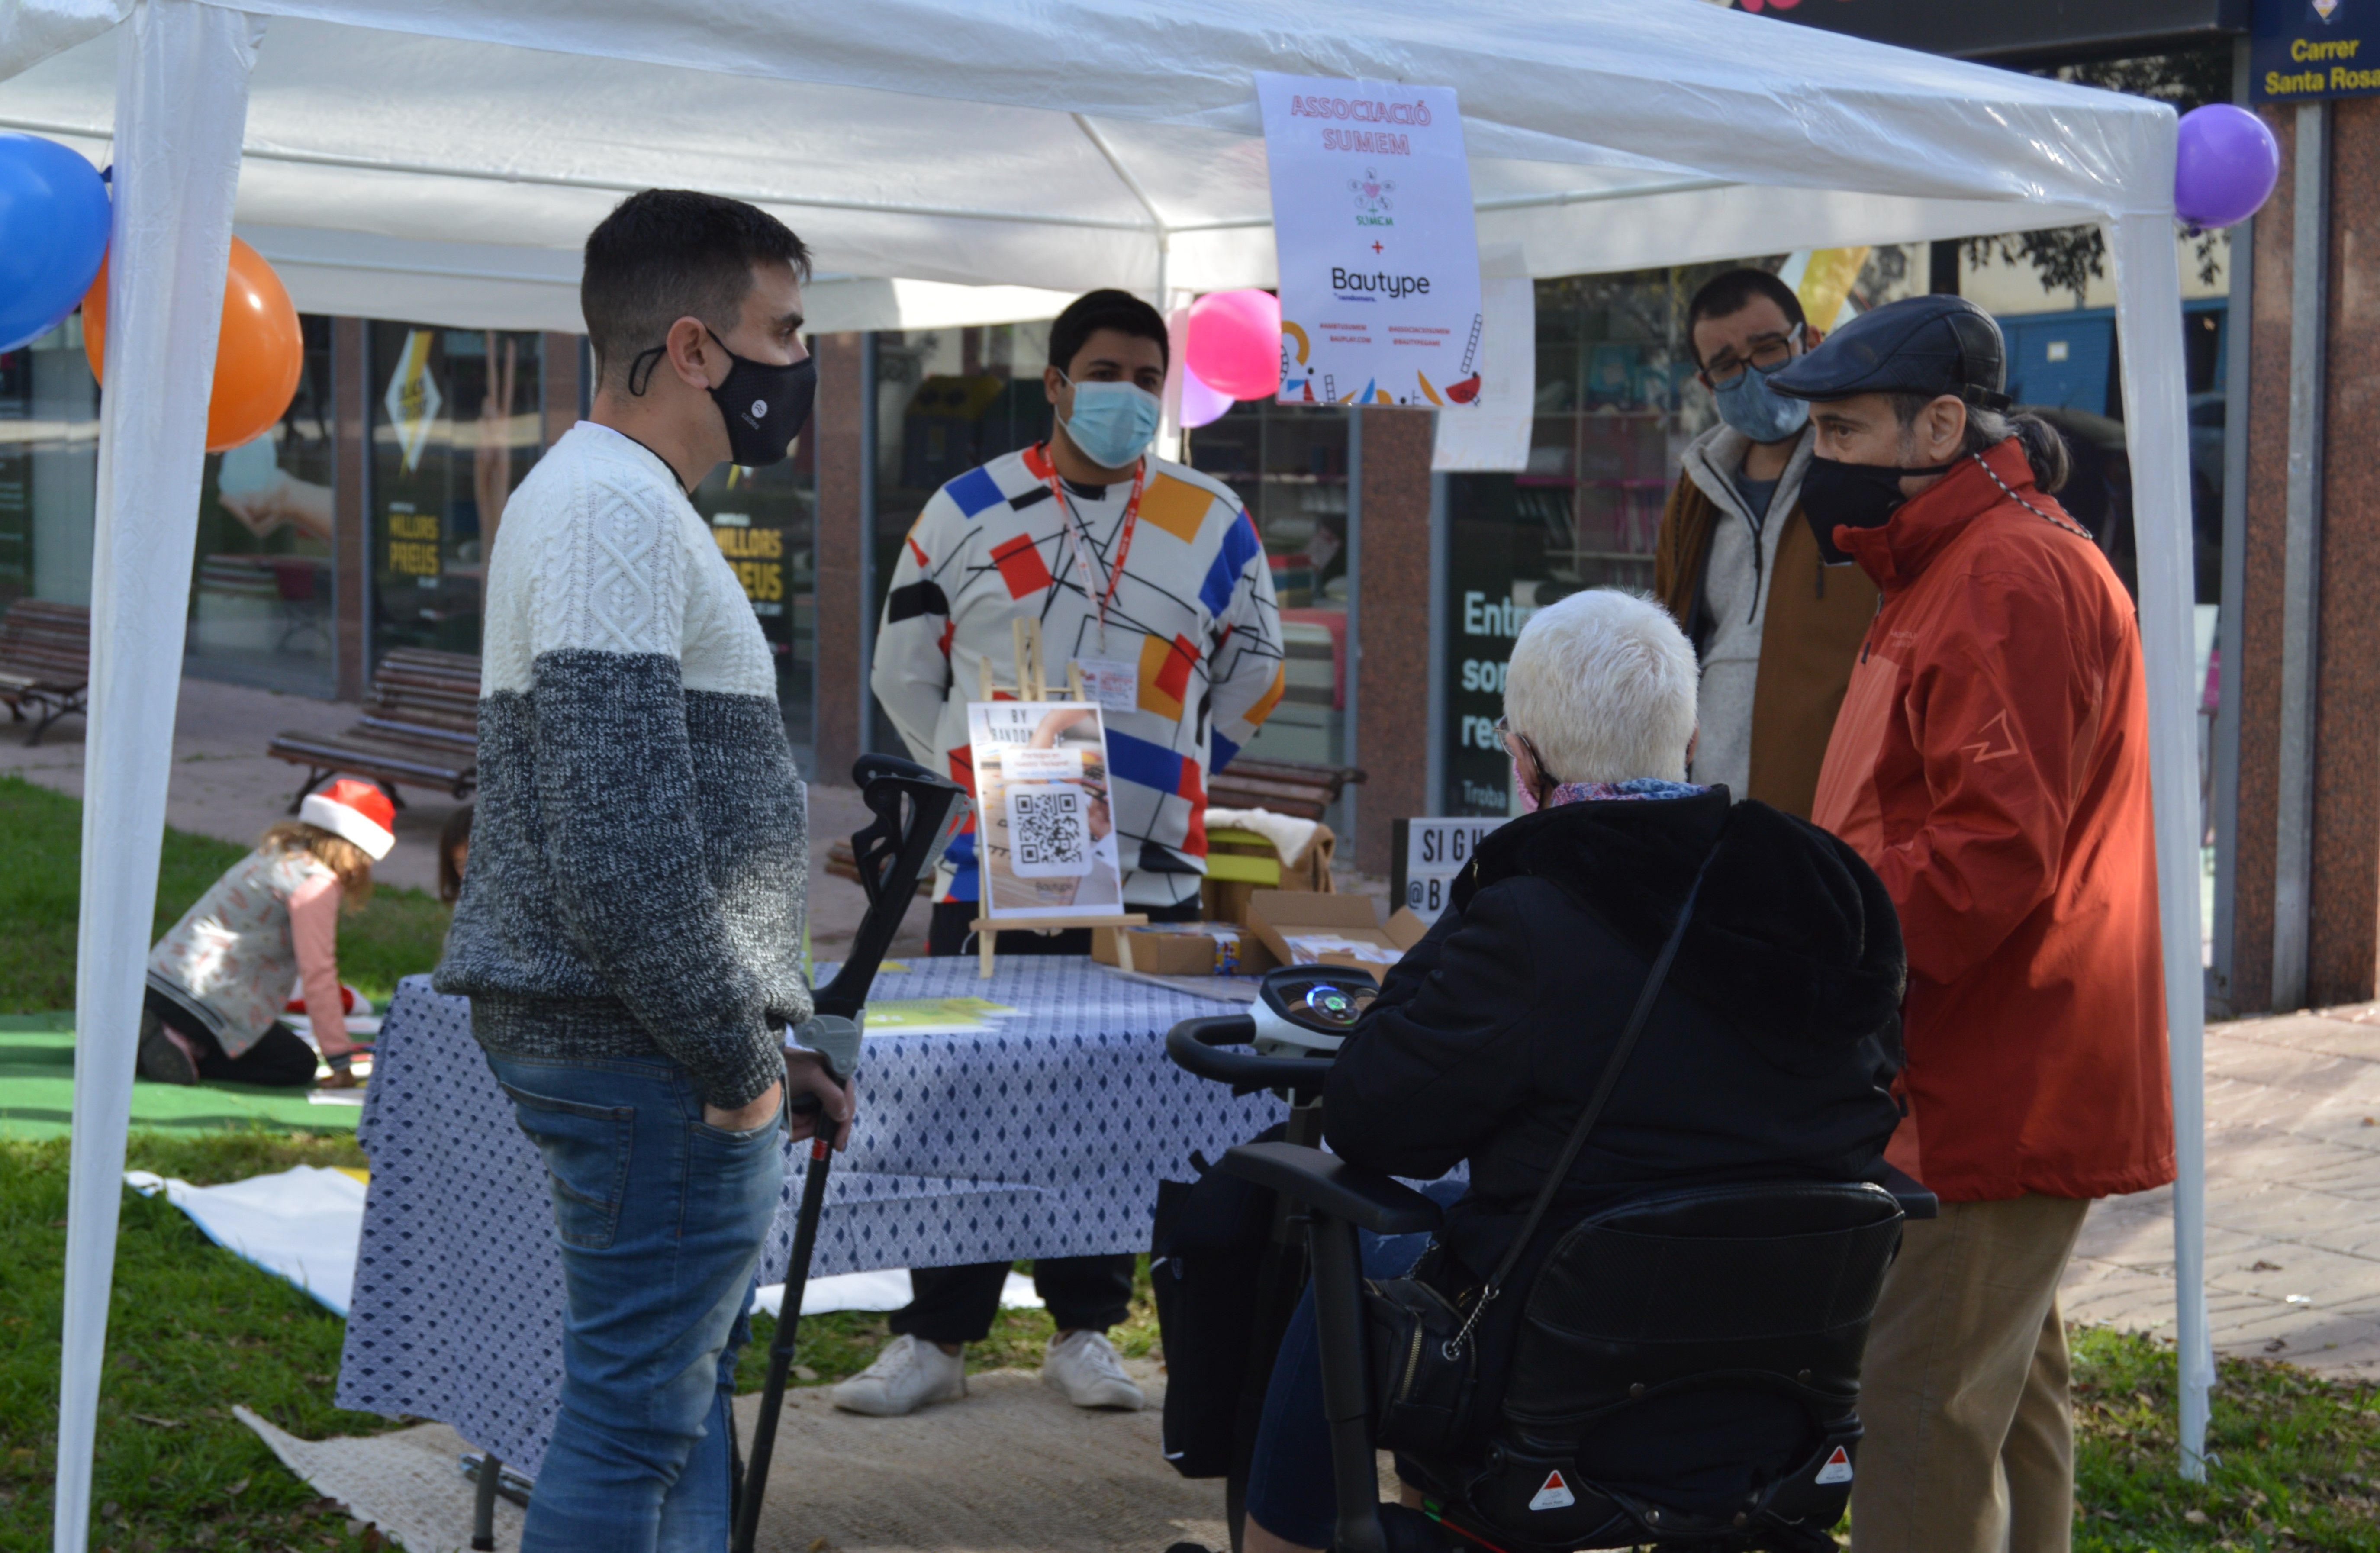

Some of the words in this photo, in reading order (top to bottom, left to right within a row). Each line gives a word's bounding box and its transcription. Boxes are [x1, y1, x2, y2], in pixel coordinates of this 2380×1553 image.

[2291, 39, 2360, 62] Carrer
[2264, 71, 2325, 95] Santa
[2330, 66, 2380, 90] Rosa
[1291, 95, 1431, 126] ASSOCIACIÓ
[1323, 129, 1410, 155] SUMEM
[1356, 216, 1394, 226] SUMEM
[1332, 267, 1431, 299] Bautype
[1464, 590, 1541, 638] Entr
[1462, 779, 1507, 809] Troba
